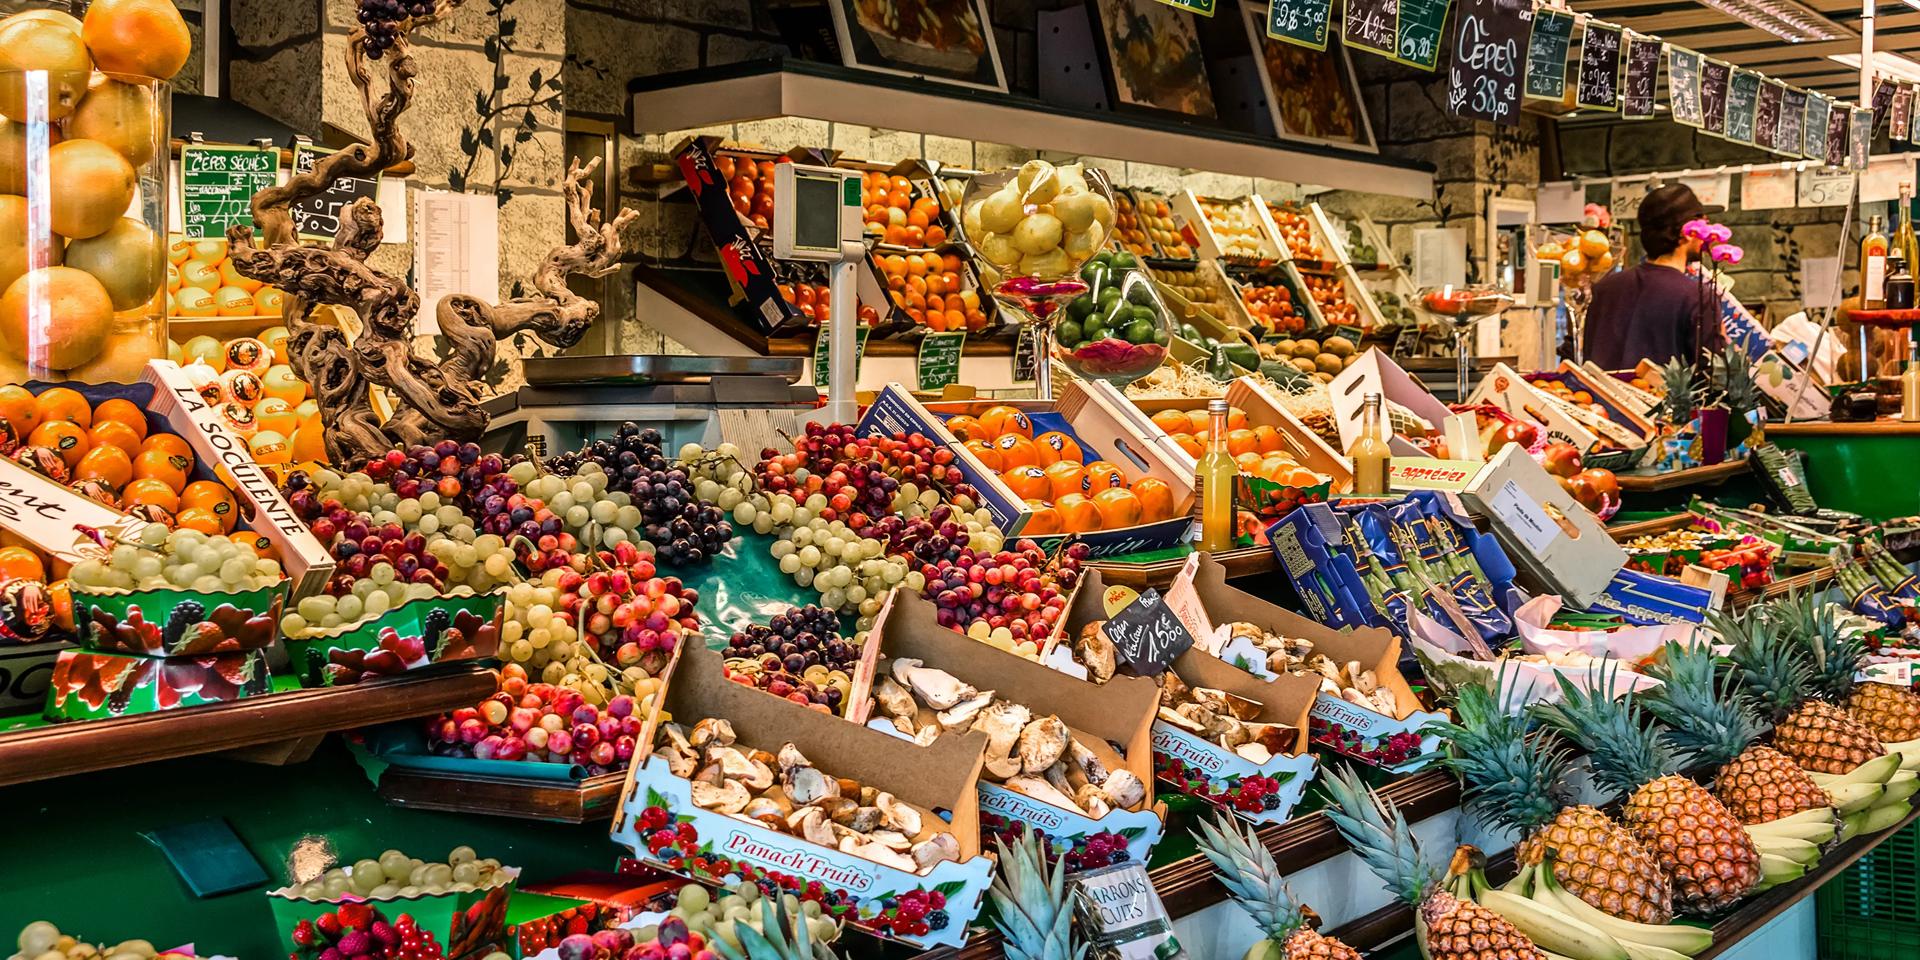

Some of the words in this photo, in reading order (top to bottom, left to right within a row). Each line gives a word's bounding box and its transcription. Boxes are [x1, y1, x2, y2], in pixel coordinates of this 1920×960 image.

[731, 234, 754, 261] Jazz
[175, 387, 205, 412] LA
[200, 422, 304, 536] SOCULENTE
[1317, 703, 1370, 729] ch'Fruits
[1152, 735, 1219, 770] ch'Fruits
[979, 793, 1059, 827] ach'Fruits
[729, 835, 869, 889] Panach'Fruits
[1085, 878, 1148, 905] ARRONS
[1100, 902, 1144, 926] CUITS
